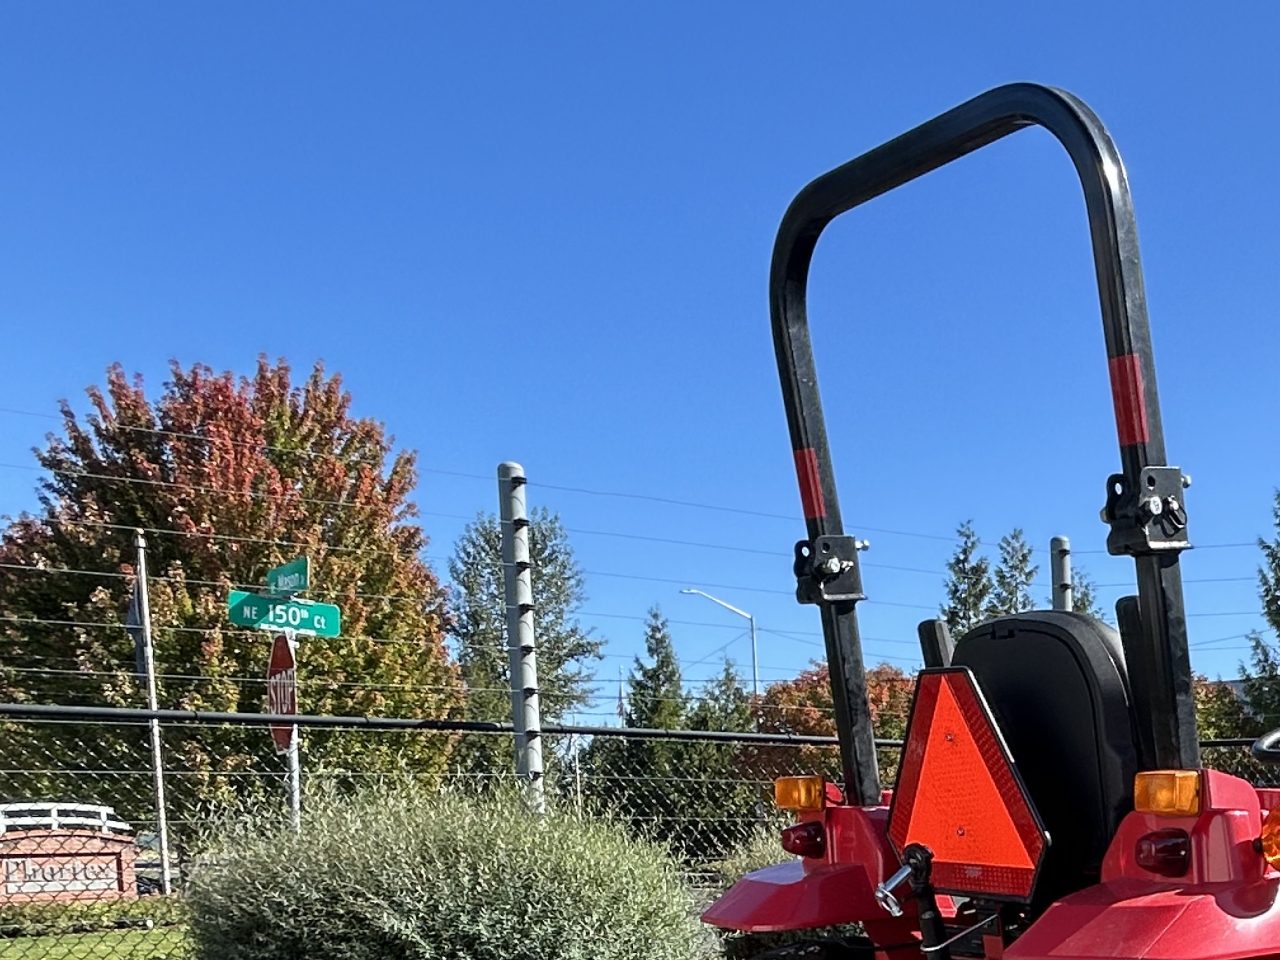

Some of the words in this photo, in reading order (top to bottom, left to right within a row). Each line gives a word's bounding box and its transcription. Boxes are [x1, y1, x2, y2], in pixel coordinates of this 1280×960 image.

[243, 606, 258, 619] NE
[268, 604, 309, 625] 150th
[313, 615, 326, 629] Ct
[270, 670, 294, 715] STOP
